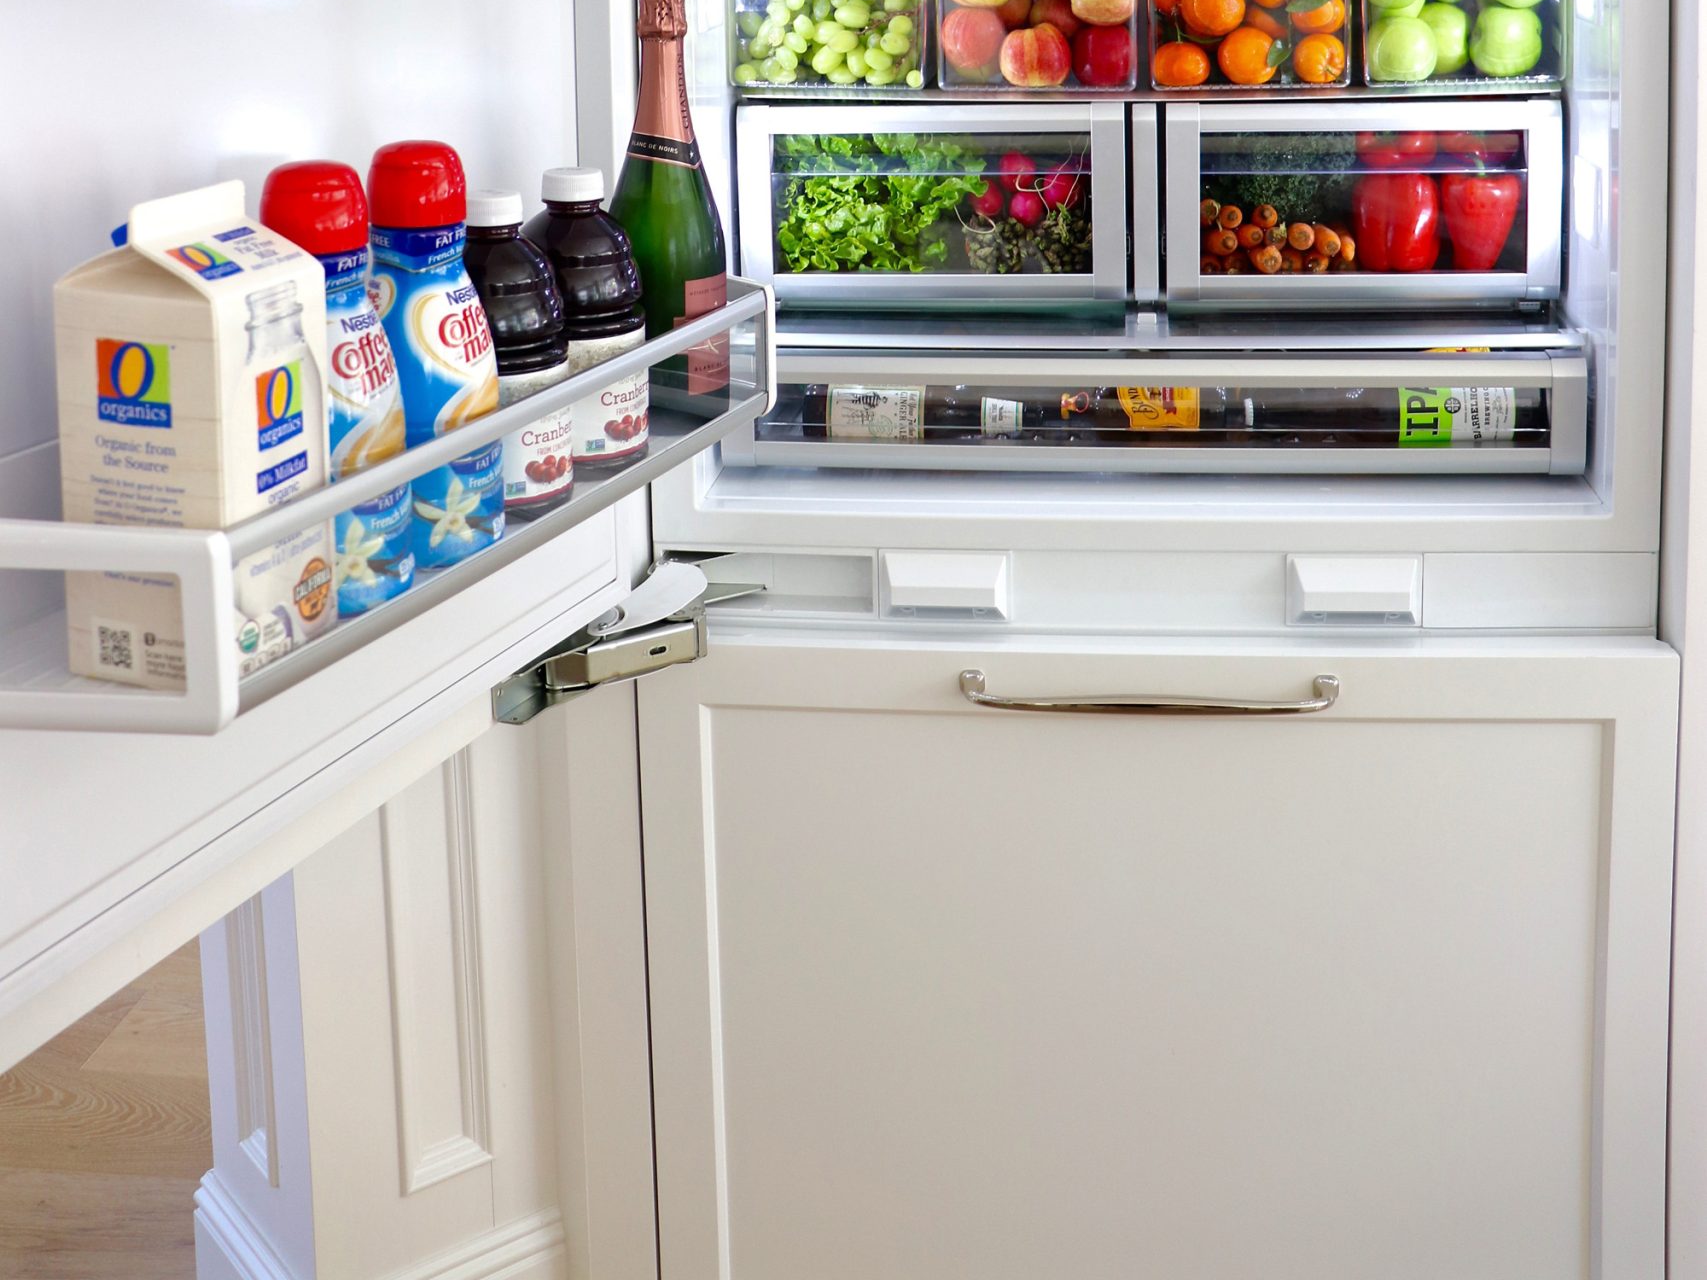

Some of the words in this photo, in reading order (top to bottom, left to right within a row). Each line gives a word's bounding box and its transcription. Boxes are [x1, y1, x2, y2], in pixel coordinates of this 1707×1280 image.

[630, 140, 647, 149] BLANC
[648, 143, 657, 151] DE
[658, 144, 679, 155] NOIRS
[435, 232, 453, 248] FAT
[337, 256, 355, 272] FAT
[428, 246, 455, 265] French
[101, 401, 168, 423] organics
[615, 404, 630, 416] FROM
[899, 391, 908, 422] GINGER
[1127, 387, 1159, 420] BUND
[1470, 387, 1482, 440] BARRELHO
[1483, 392, 1491, 426] BREWING
[260, 416, 302, 445] organics
[899, 423, 908, 441] ALE
[95, 434, 142, 455] Organic
[144, 441, 176, 458] from
[536, 444, 552, 456] FROM
[103, 453, 122, 468] the
[124, 456, 169, 474] Source
[258, 470, 274, 489] 0%
[274, 453, 307, 481] Milkfat
[475, 457, 490, 471] FAT
[468, 472, 496, 488] French
[268, 481, 301, 505] organic
[378, 495, 395, 511] FAT
[371, 511, 401, 529] French
[295, 566, 332, 600] CALIFORNIA
